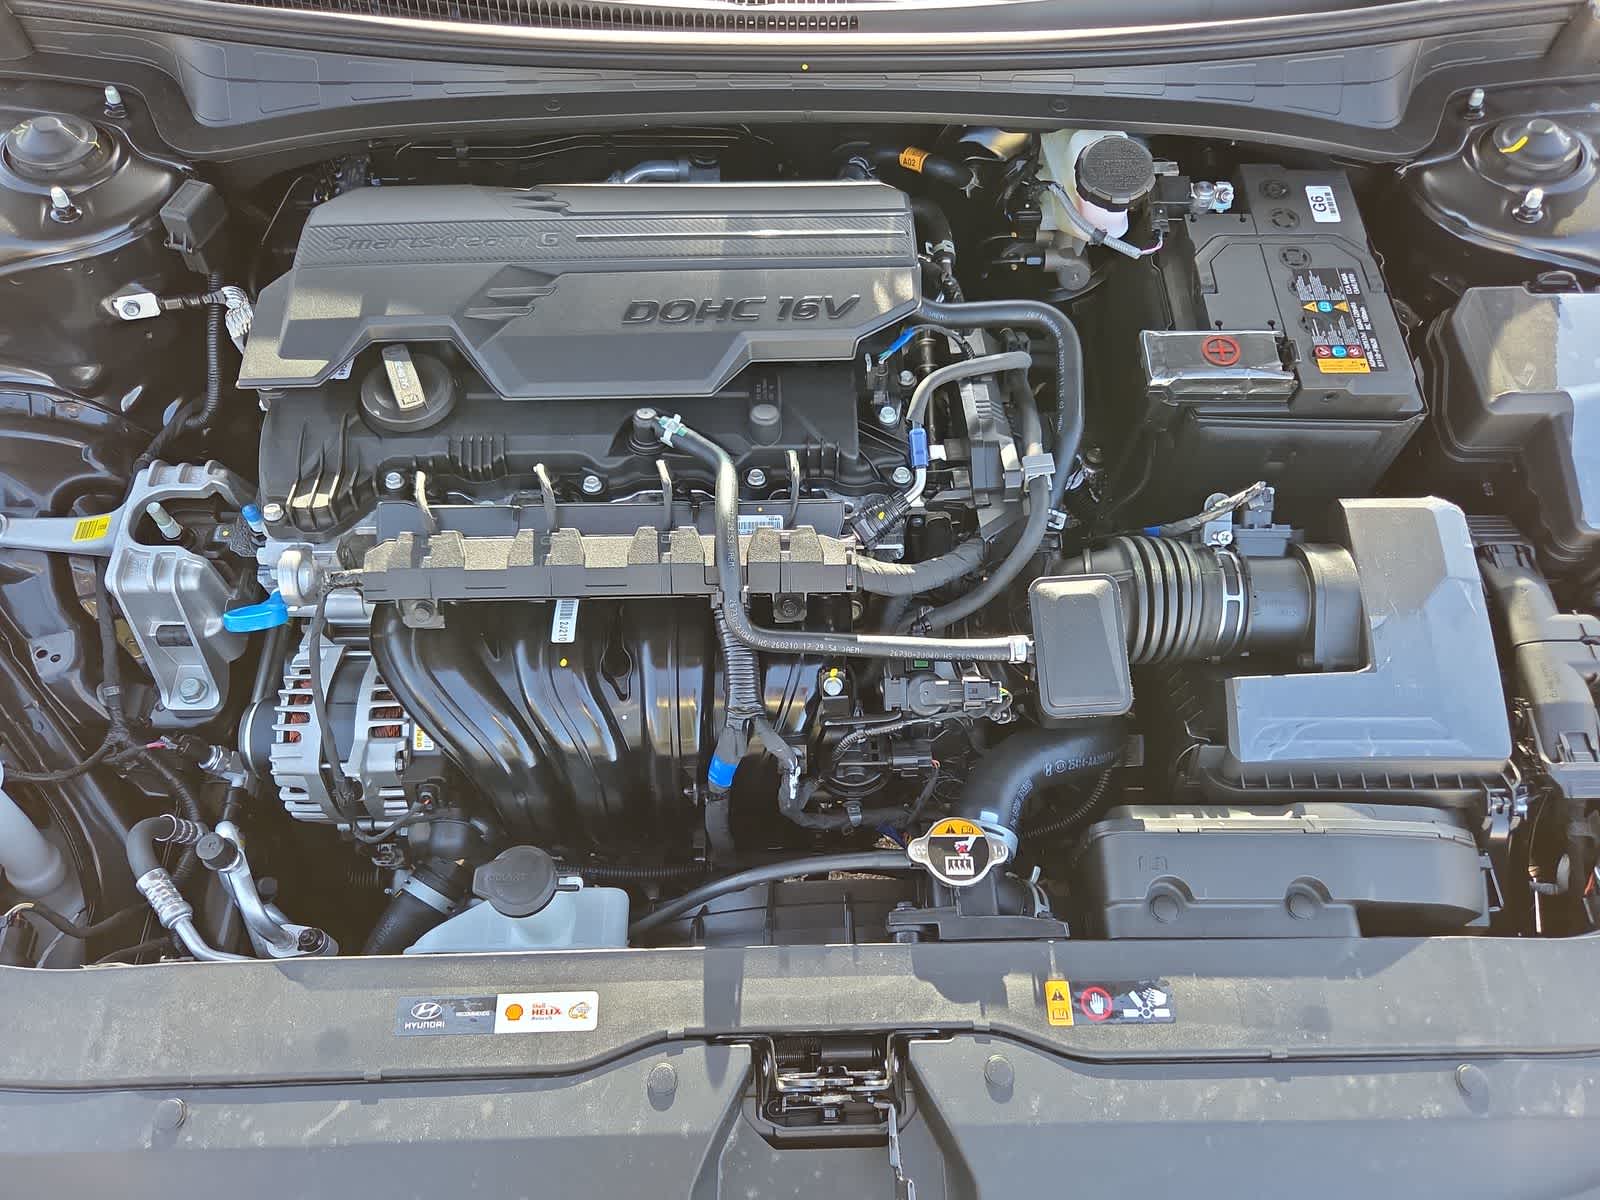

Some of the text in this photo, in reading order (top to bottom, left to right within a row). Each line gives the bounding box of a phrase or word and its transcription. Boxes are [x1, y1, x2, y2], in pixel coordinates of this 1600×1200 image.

[902, 158, 916, 167] A02
[1313, 195, 1328, 213] G6
[536, 231, 561, 248] G
[621, 294, 861, 325] DOHC 16V
[531, 1008, 562, 1016] HELIX
[404, 1020, 446, 1030] HYUNDAI
